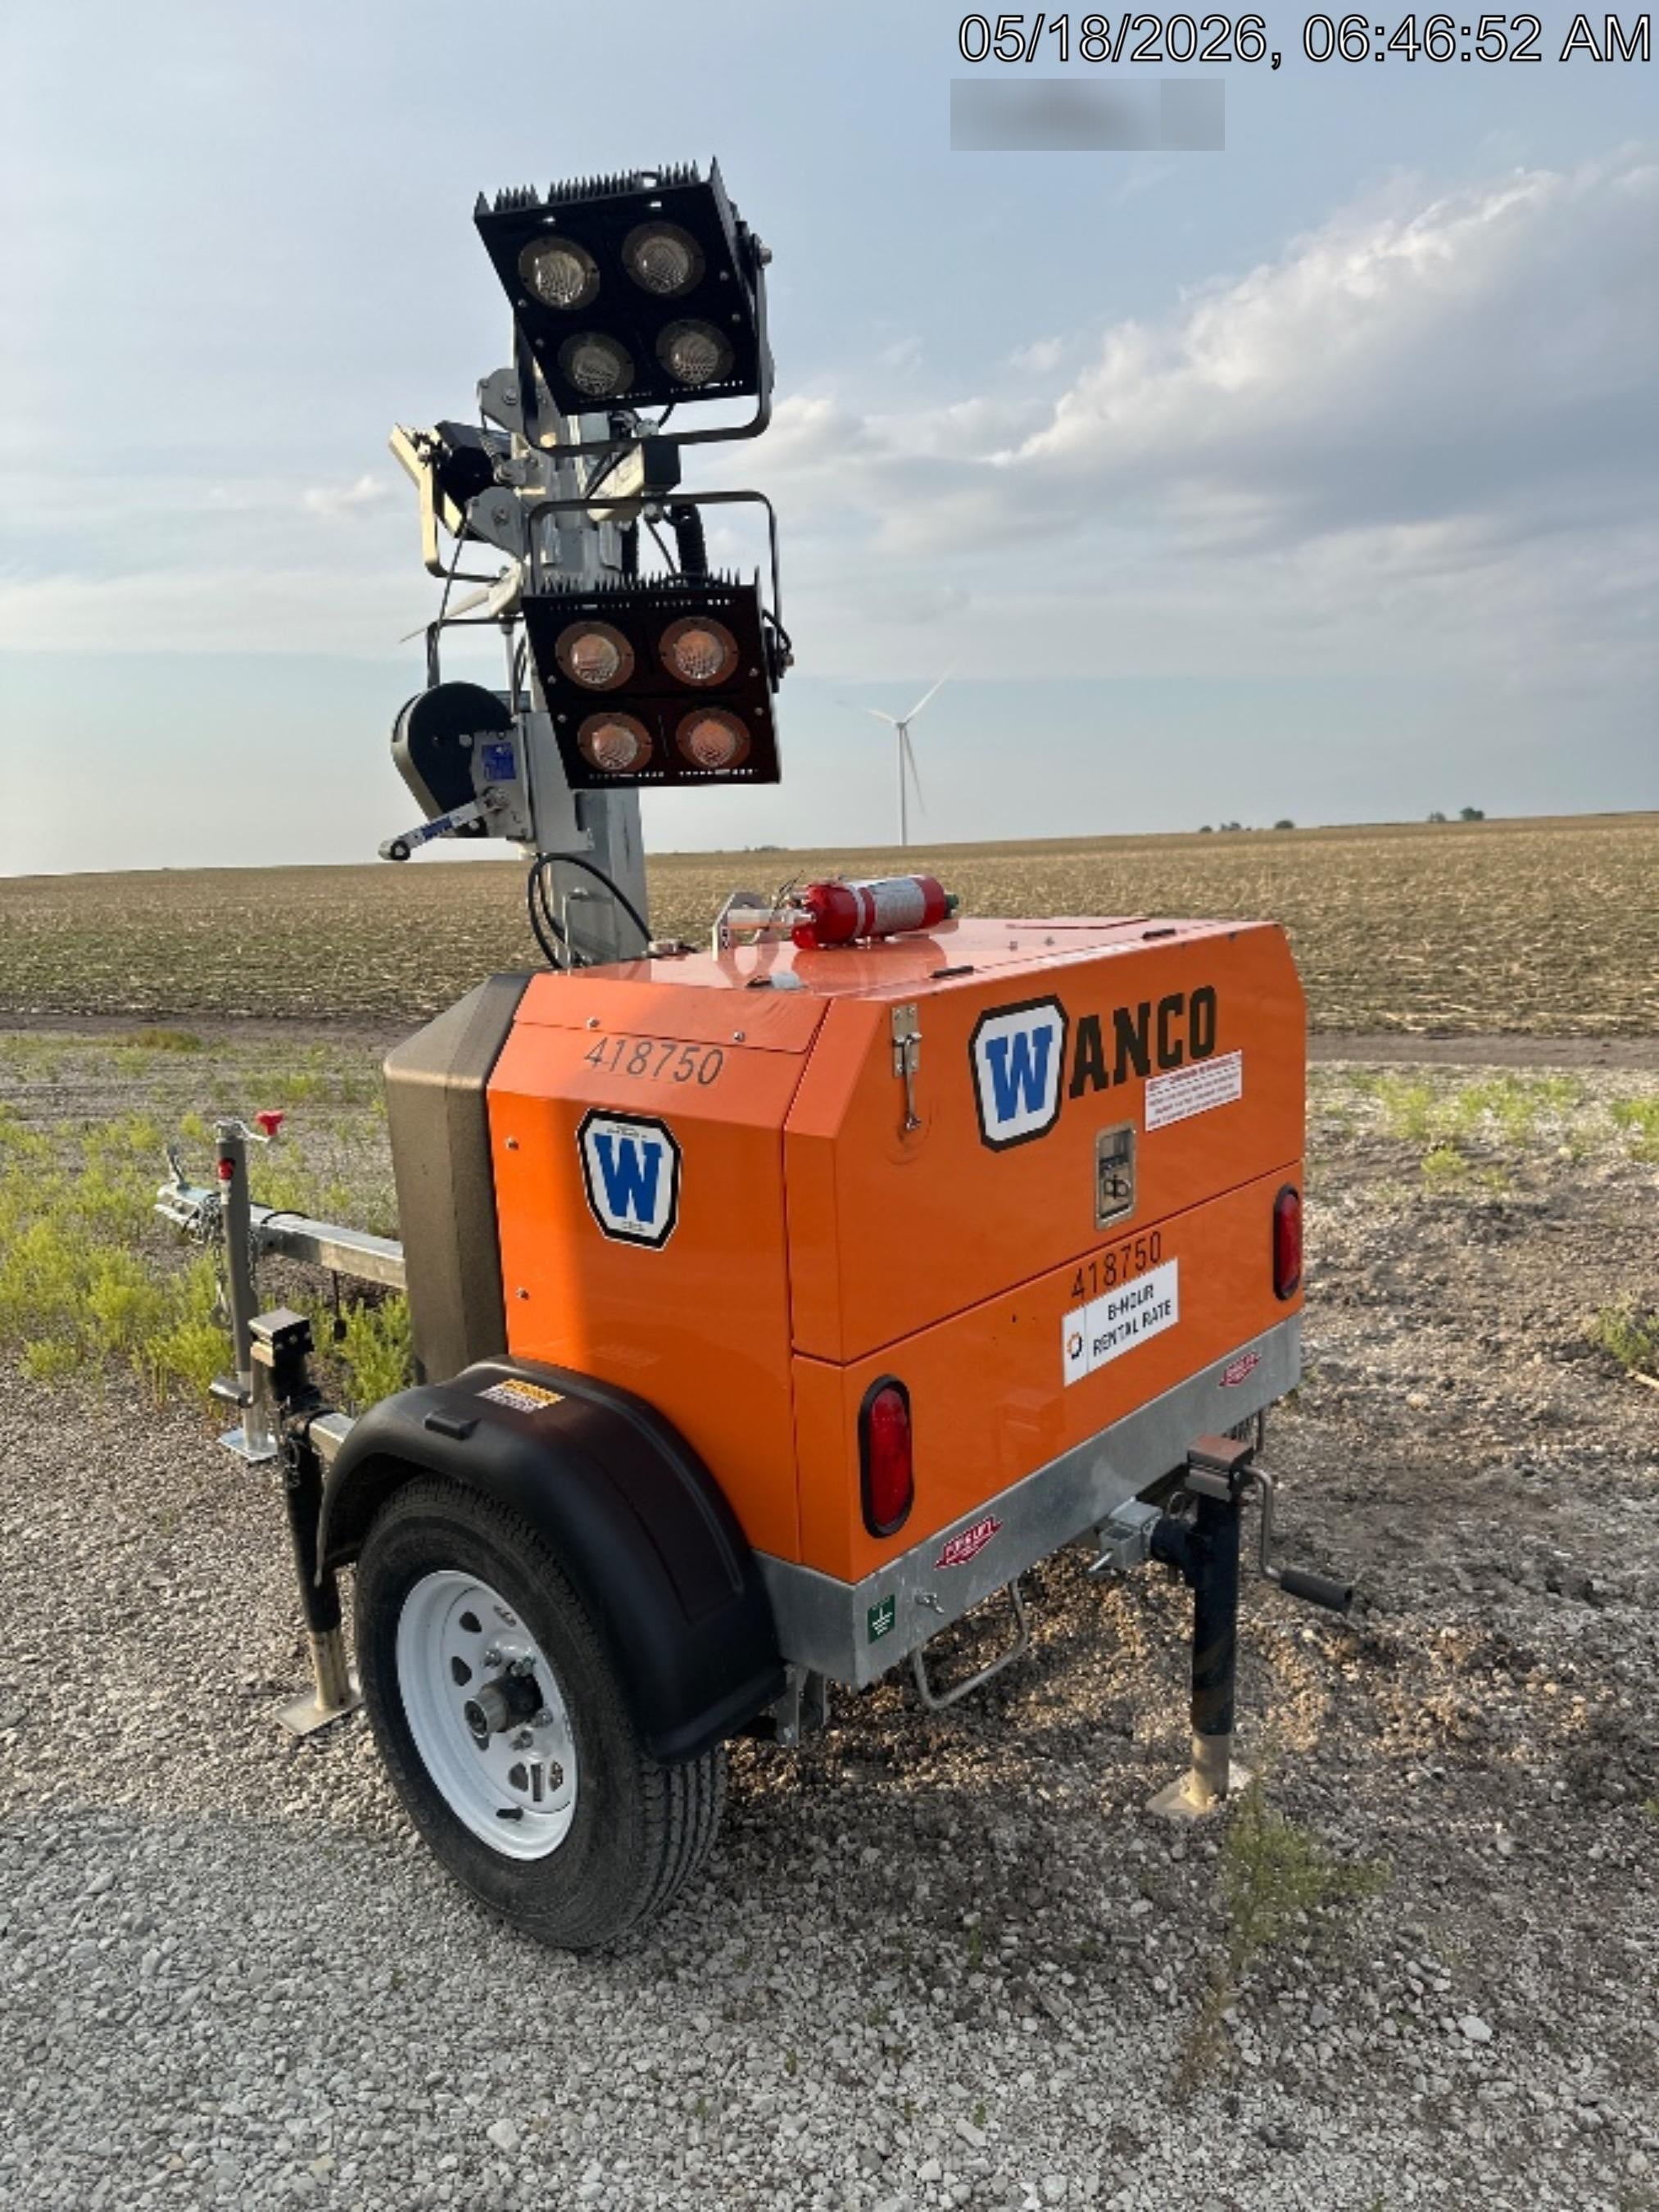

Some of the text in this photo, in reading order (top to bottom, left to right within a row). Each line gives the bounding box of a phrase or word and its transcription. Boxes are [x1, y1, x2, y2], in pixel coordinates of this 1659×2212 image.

[584, 1036, 724, 1086] 418750
[986, 986, 1217, 1123] WANCO
[593, 1132, 663, 1224] W
[1072, 1231, 1162, 1301] 418750
[1093, 1299, 1172, 1358] RENTAL RATE
